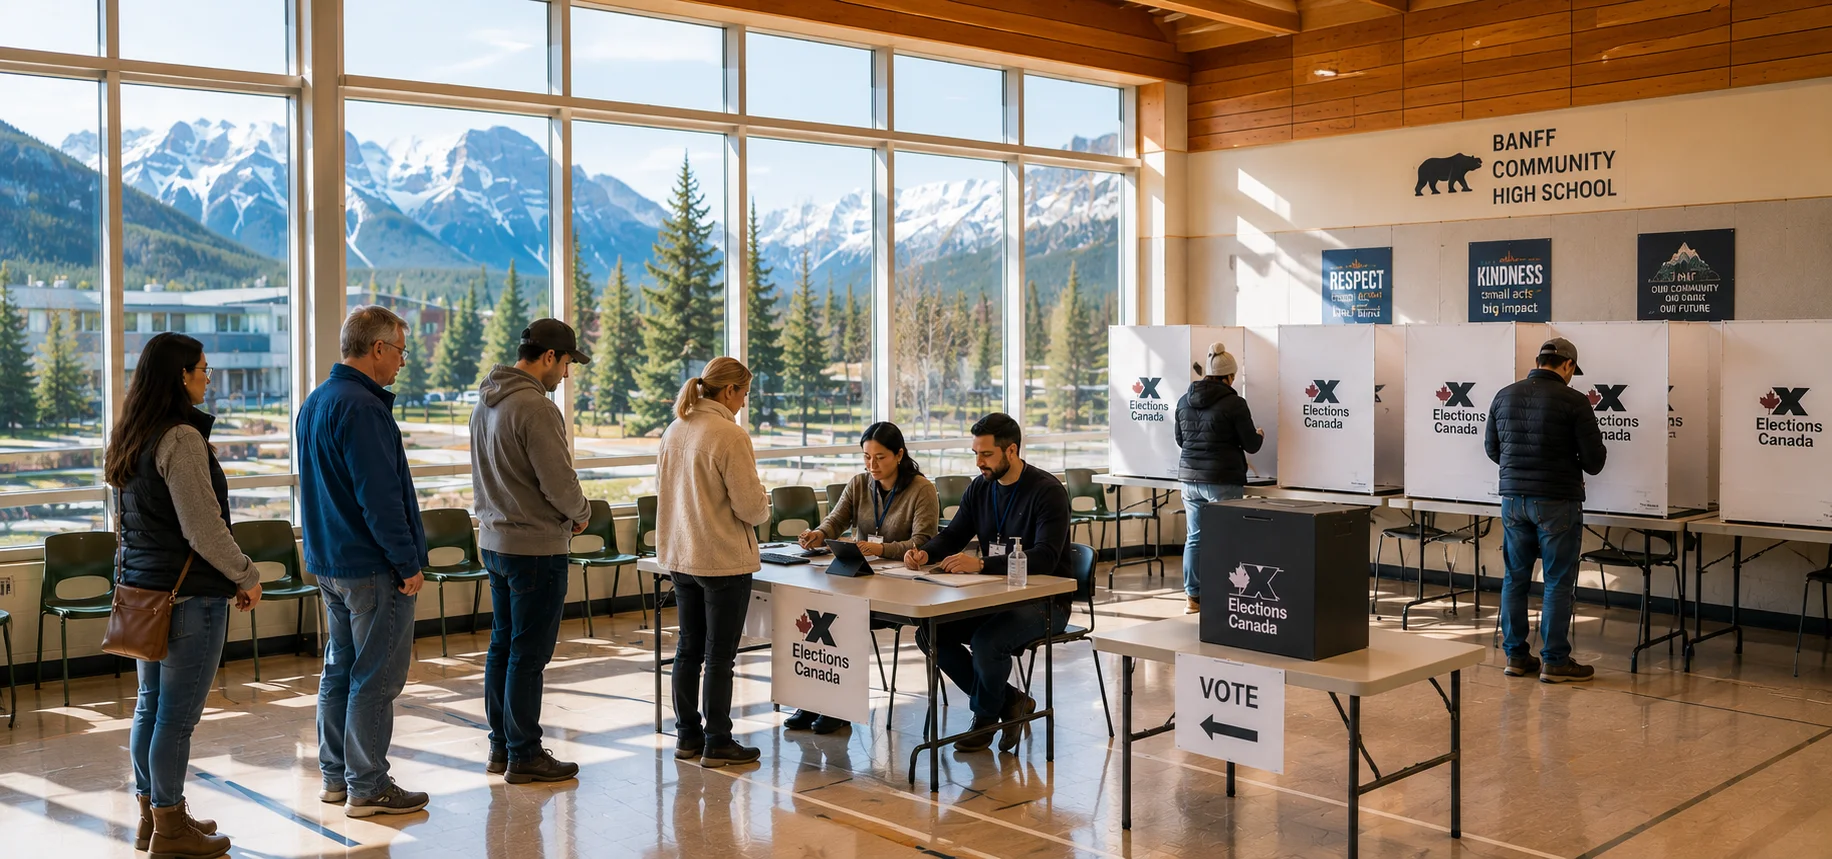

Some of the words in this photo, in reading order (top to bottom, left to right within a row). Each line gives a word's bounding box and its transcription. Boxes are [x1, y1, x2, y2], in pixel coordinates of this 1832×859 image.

[1493, 128, 1556, 151] BANFF
[1493, 150, 1616, 178] COMMUNITY
[1493, 185, 1536, 204] HIGH
[1541, 178, 1617, 201] SCHOOL
[1329, 269, 1384, 290] RESPECT
[1482, 302, 1499, 316] big
[1501, 302, 1539, 315] impact
[1678, 303, 1711, 313] FUTURE
[1130, 400, 1169, 411] Elections
[1303, 404, 1349, 417] Elections
[1131, 410, 1164, 421] Canada
[1433, 408, 1486, 422] Elections
[1595, 414, 1639, 427] ections
[1304, 417, 1343, 429] Canada
[1434, 422, 1478, 435] Canada
[1756, 418, 1823, 433] Elections
[1600, 428, 1631, 441] nada
[1758, 433, 1814, 448] Canada
[1229, 598, 1288, 619] Elections
[1229, 614, 1278, 635] Canada
[792, 643, 850, 669] Elections
[794, 661, 841, 685] Canada
[1200, 676, 1259, 709] VOTE
